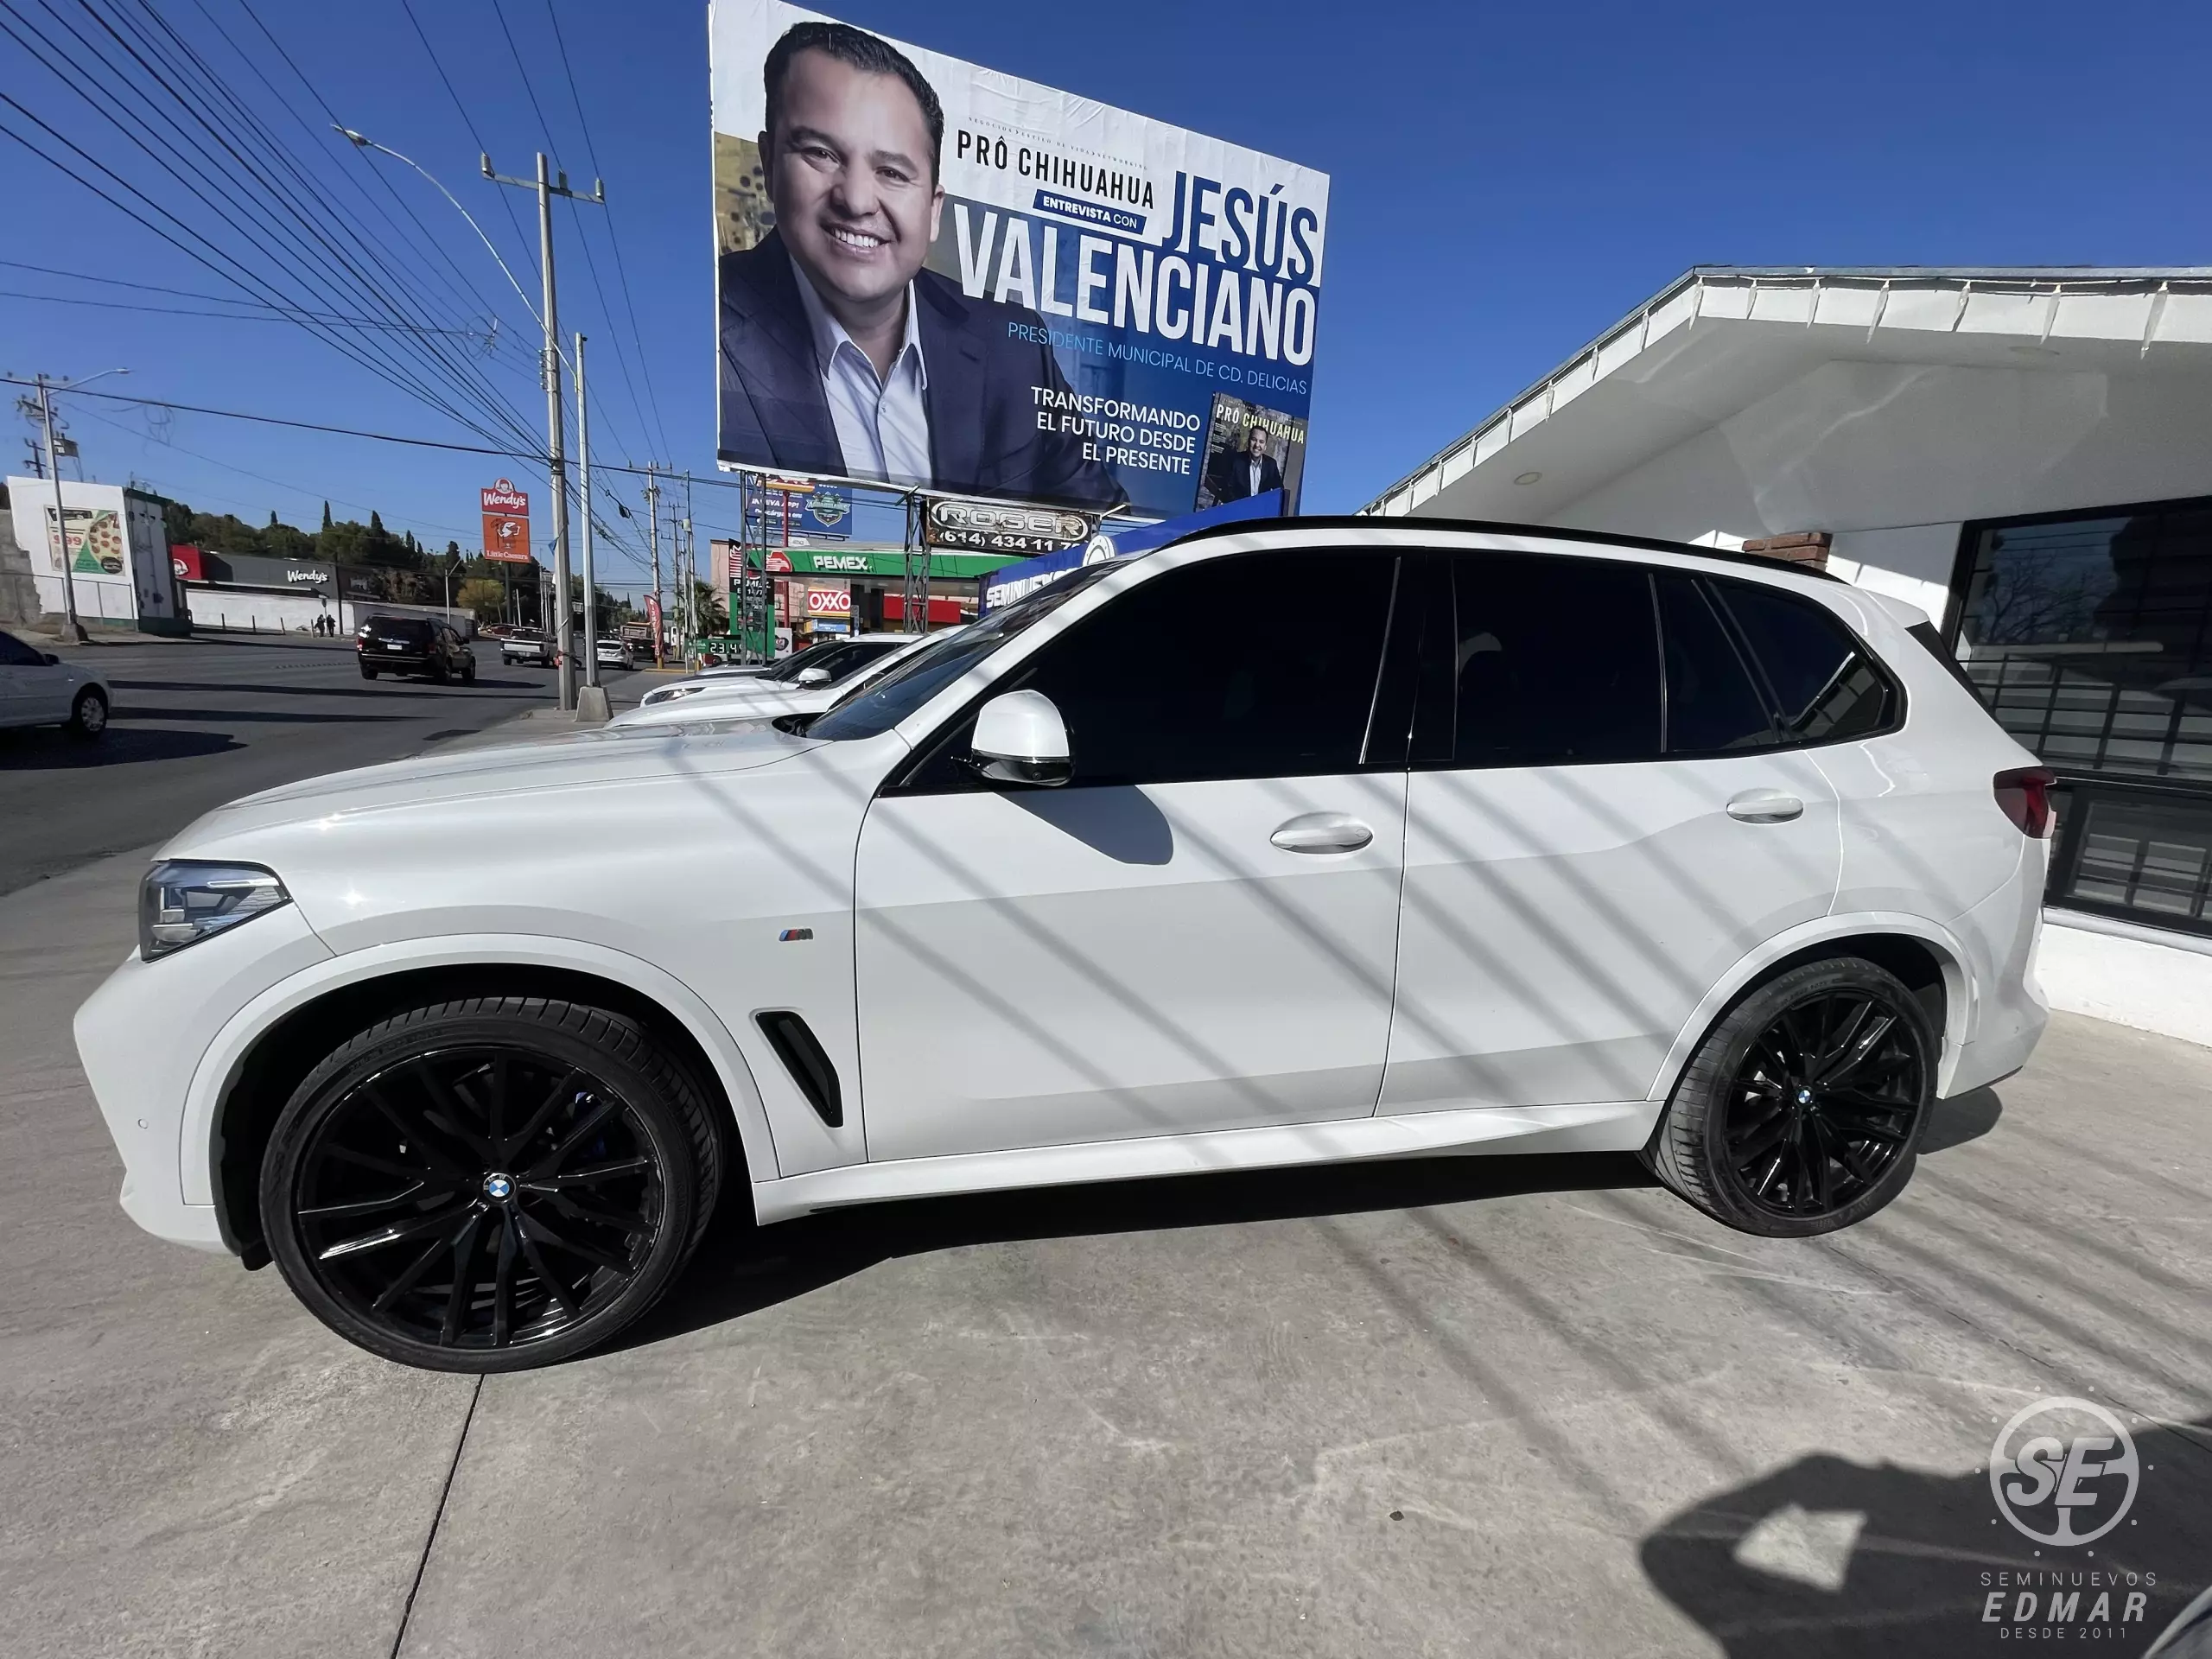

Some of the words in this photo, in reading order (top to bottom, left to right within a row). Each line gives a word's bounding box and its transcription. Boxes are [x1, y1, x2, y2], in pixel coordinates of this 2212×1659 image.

[1019, 148, 1154, 209] CHIHUAHUA
[1043, 196, 1111, 222] ENTREVISTA
[1113, 213, 1138, 229] CON
[1161, 171, 1318, 281] JESÚS
[954, 205, 1314, 366] VALENCIANO
[1008, 321, 1103, 355] PRESIDENTE
[1108, 344, 1192, 373] MUNICIPAL
[1196, 360, 1214, 378] DE
[1218, 365, 1243, 385] CD.
[1249, 370, 1307, 395] DELICIAS
[1031, 386, 1200, 431] TRANSFORMANDO
[1037, 411, 1056, 431] EL
[1062, 416, 1135, 447] FUTURO
[1140, 430, 1195, 454] DESDE
[1243, 413, 1305, 444] CHIHUAHUA
[1083, 442, 1101, 461] EL
[1106, 445, 1191, 475] PRESENTE
[483, 492, 526, 509] Wendy's
[939, 506, 1081, 536] ROGER
[939, 531, 986, 547] (614)
[991, 535, 1027, 549] 434
[1031, 539, 1053, 551] 11
[287, 569, 327, 584] Wendy's
[813, 556, 868, 570] PEMEX
[809, 592, 850, 612] OXXO
